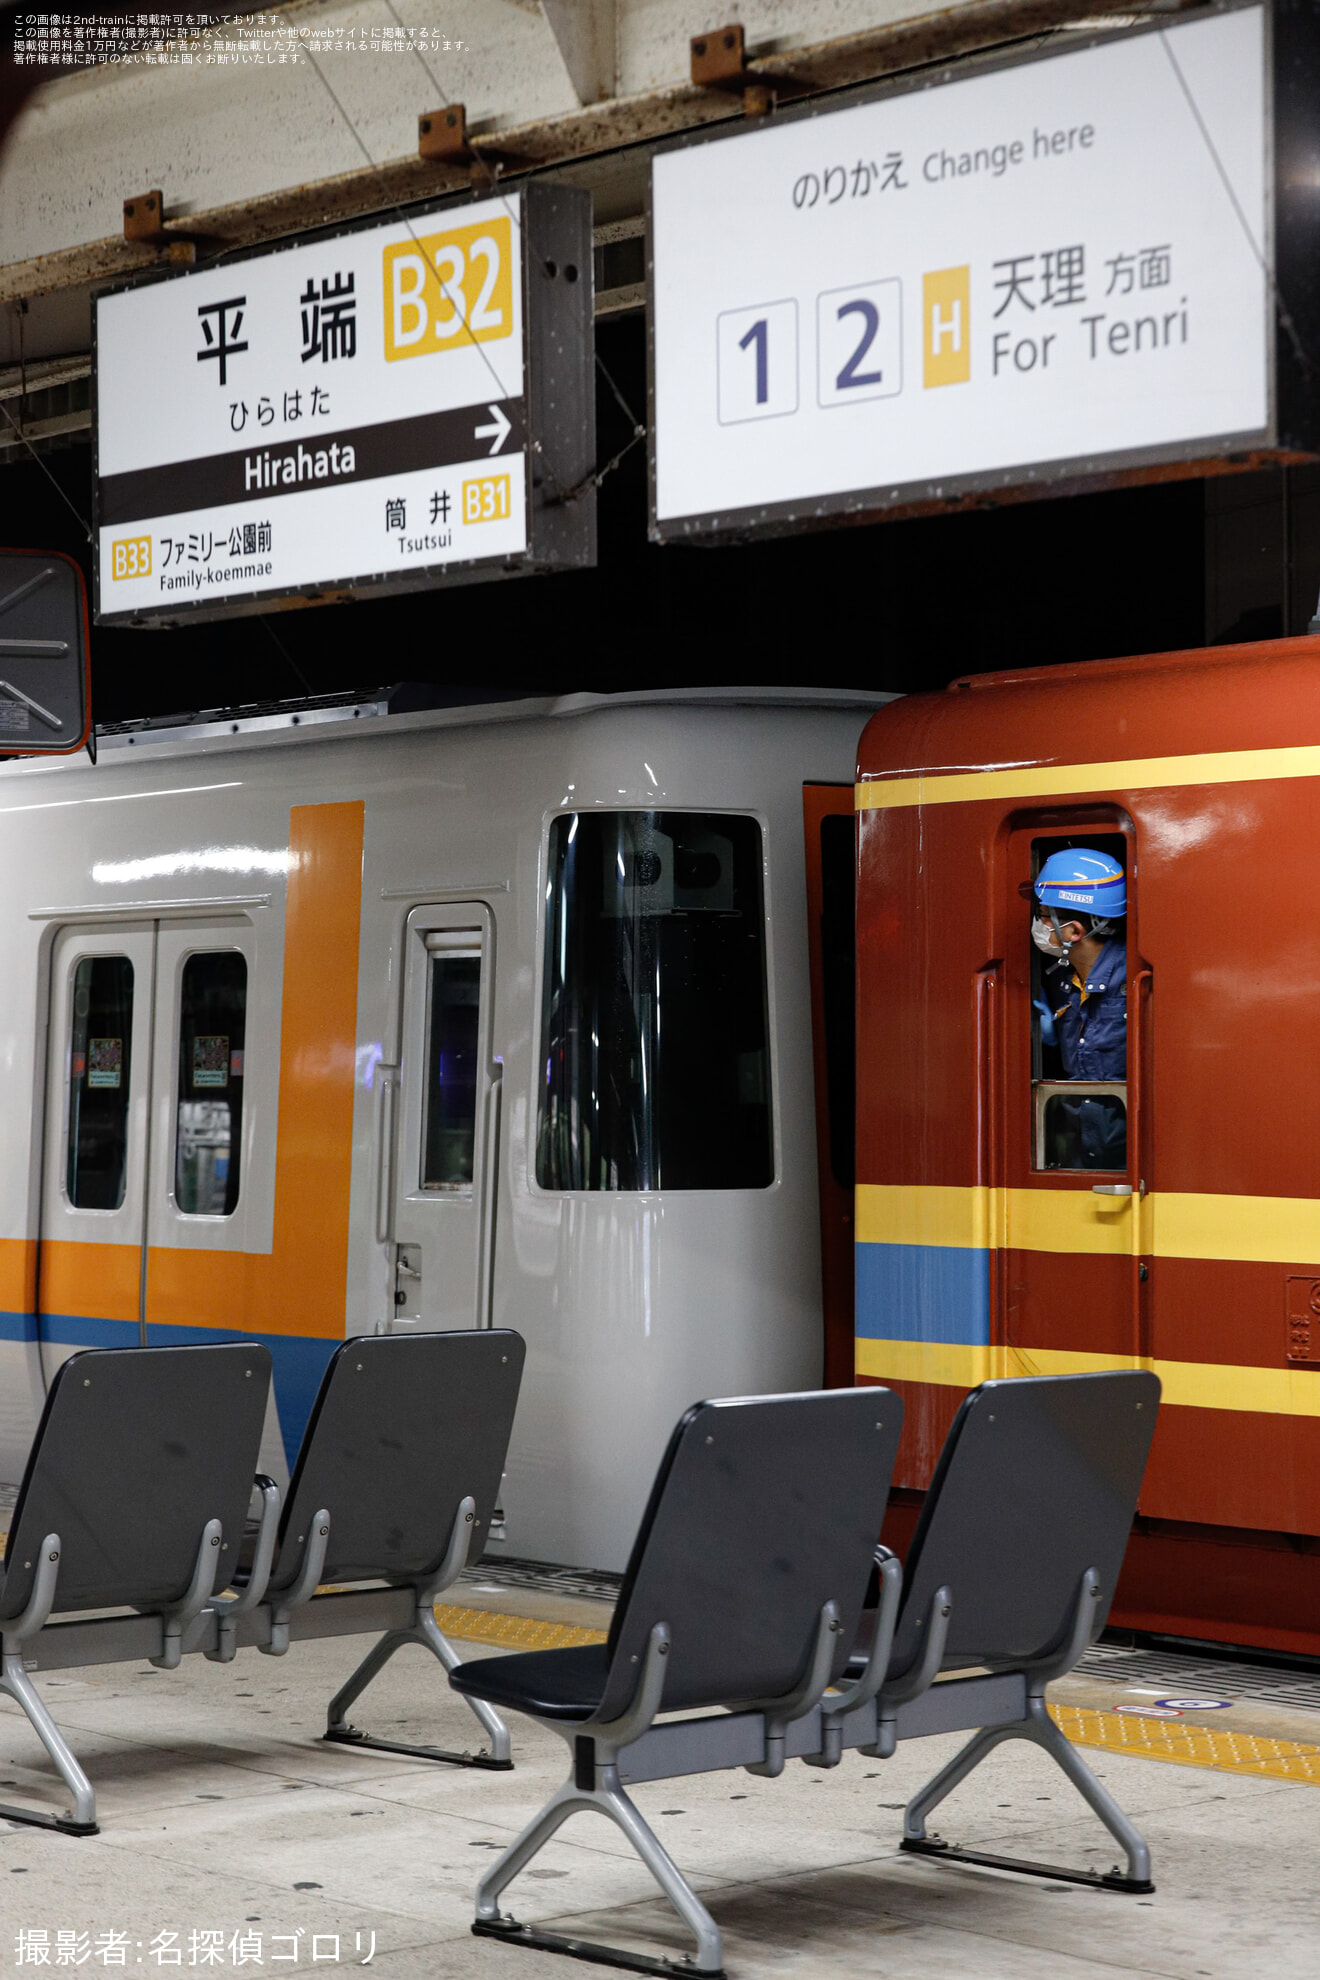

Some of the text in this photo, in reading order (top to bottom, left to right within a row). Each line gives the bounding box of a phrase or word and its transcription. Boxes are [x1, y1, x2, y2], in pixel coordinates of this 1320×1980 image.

[792, 121, 1096, 209] のりかえ Change here
[392, 237, 504, 348] B32
[738, 299, 962, 404] 1 2 H
[992, 297, 1188, 376] For Tenri
[229, 385, 331, 432] ひらはた
[244, 443, 356, 491] Hirahata
[466, 478, 508, 521] B31
[114, 520, 273, 577] B33 ファミリー公園前
[398, 532, 452, 555] Tsutsui
[159, 561, 273, 591] Family-koemmae
